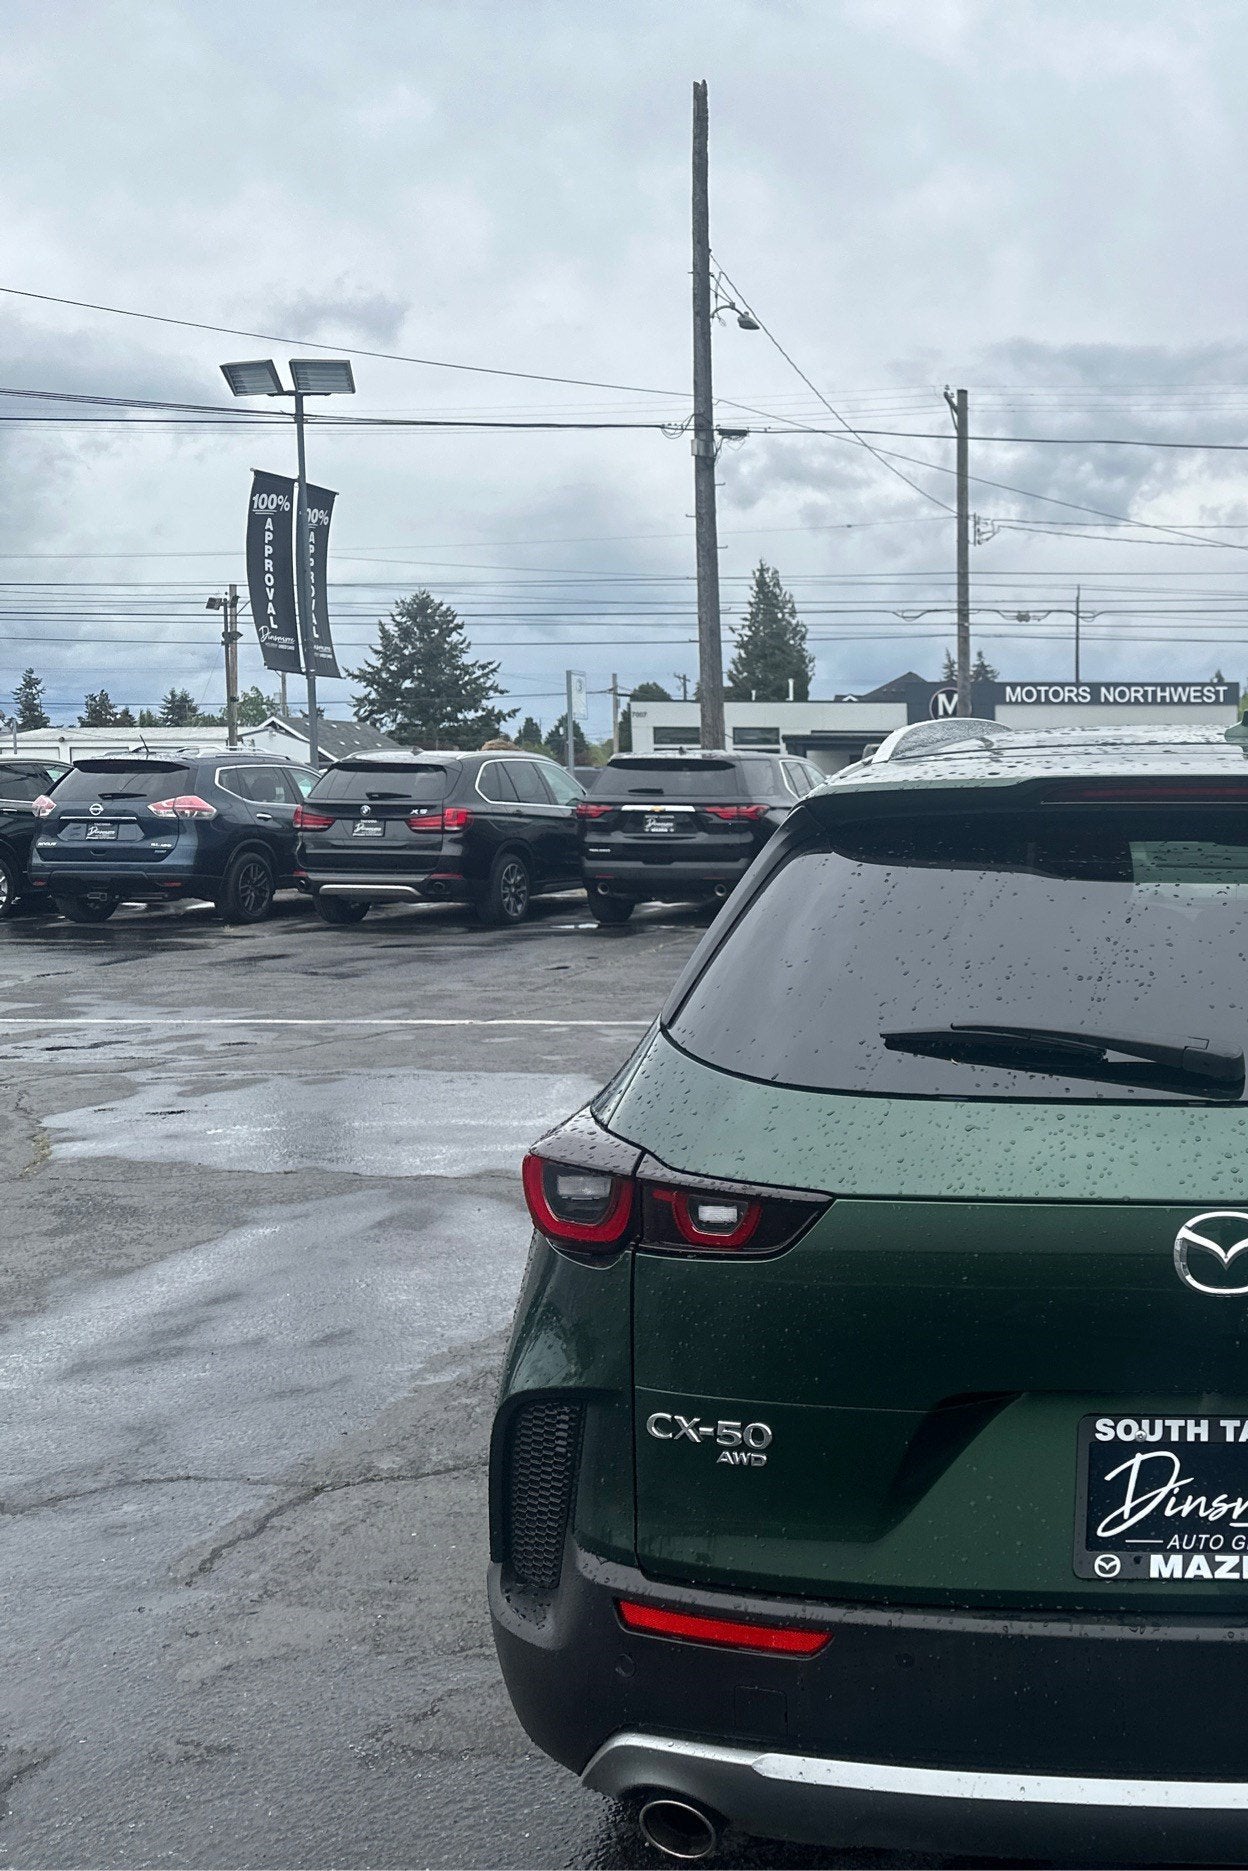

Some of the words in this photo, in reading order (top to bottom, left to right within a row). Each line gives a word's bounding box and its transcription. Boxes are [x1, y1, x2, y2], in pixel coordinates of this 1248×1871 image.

[252, 493, 290, 512] 100%
[264, 517, 278, 629] APPROVAL
[1005, 686, 1091, 703] MOTORS
[1100, 686, 1229, 703] NORTHWEST
[646, 1412, 772, 1450] CX-50
[1095, 1419, 1209, 1442] SOUTH
[716, 1451, 767, 1467] AWD
[1166, 1534, 1224, 1550] AUTO
